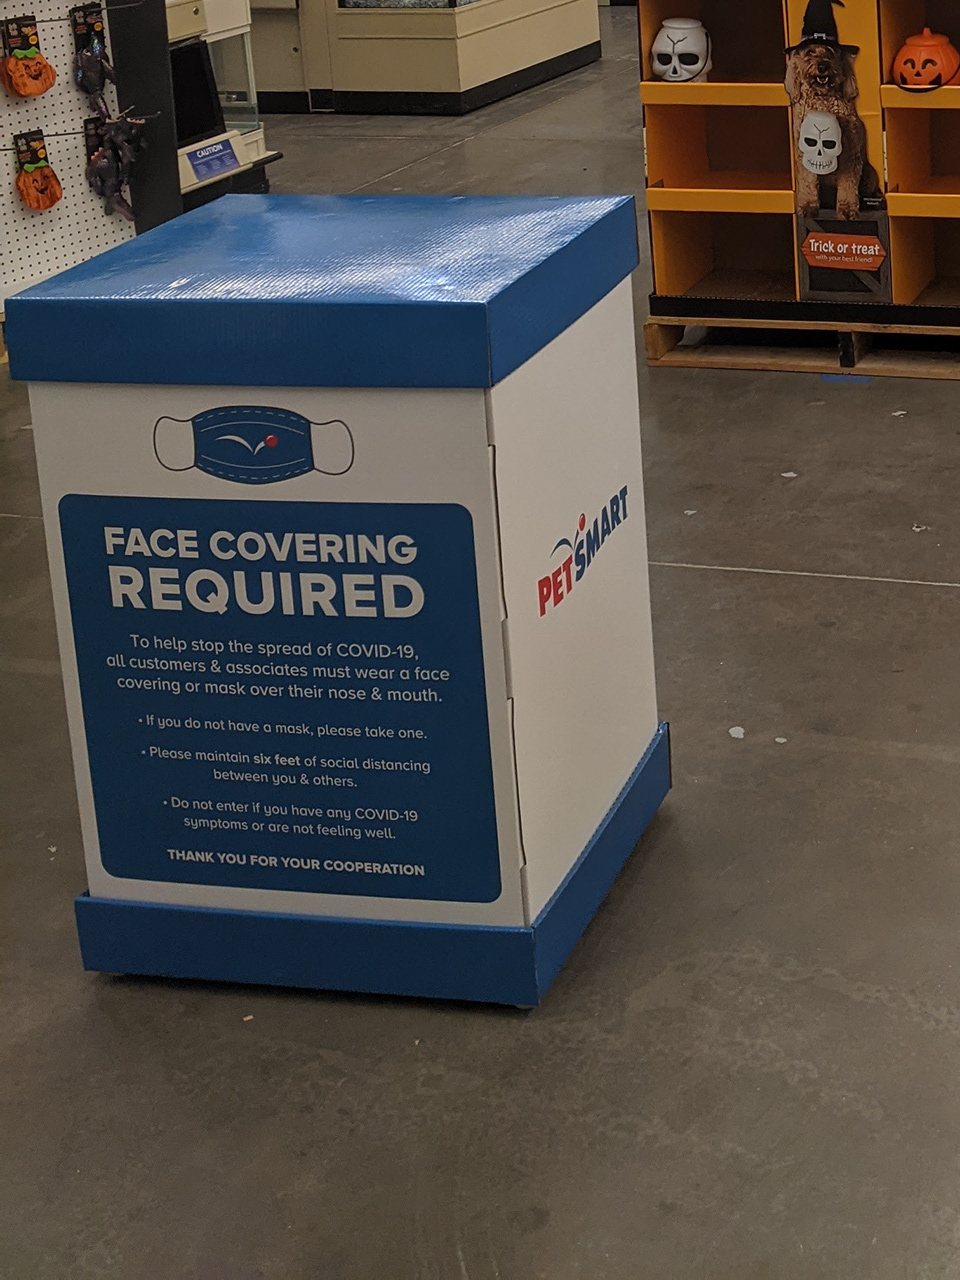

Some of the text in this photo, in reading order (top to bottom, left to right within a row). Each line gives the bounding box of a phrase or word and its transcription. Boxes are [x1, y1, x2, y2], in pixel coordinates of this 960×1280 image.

[196, 143, 223, 158] CAUTION
[809, 238, 880, 255] Trick or treat
[103, 526, 418, 565] FACE COVERING
[537, 485, 628, 617] PETSMART
[108, 565, 425, 618] REQUIRED
[129, 634, 419, 661] To help stop the spread of COVID-19,
[106, 654, 450, 681] all customers & associates must wear a face
[117, 677, 442, 702] covering or mask over their nose & mouth.
[146, 714, 428, 739] If you do not have a mask, please take one.
[149, 746, 431, 775] Please maintain six feet of social distancing
[213, 768, 358, 787] between you & others.
[171, 796, 418, 822] Do not enter if you have any COVID-19
[183, 817, 396, 840] symptoms or are not feeling well.
[167, 849, 425, 876] THANK YOU FOR YOUR COOPERATION
